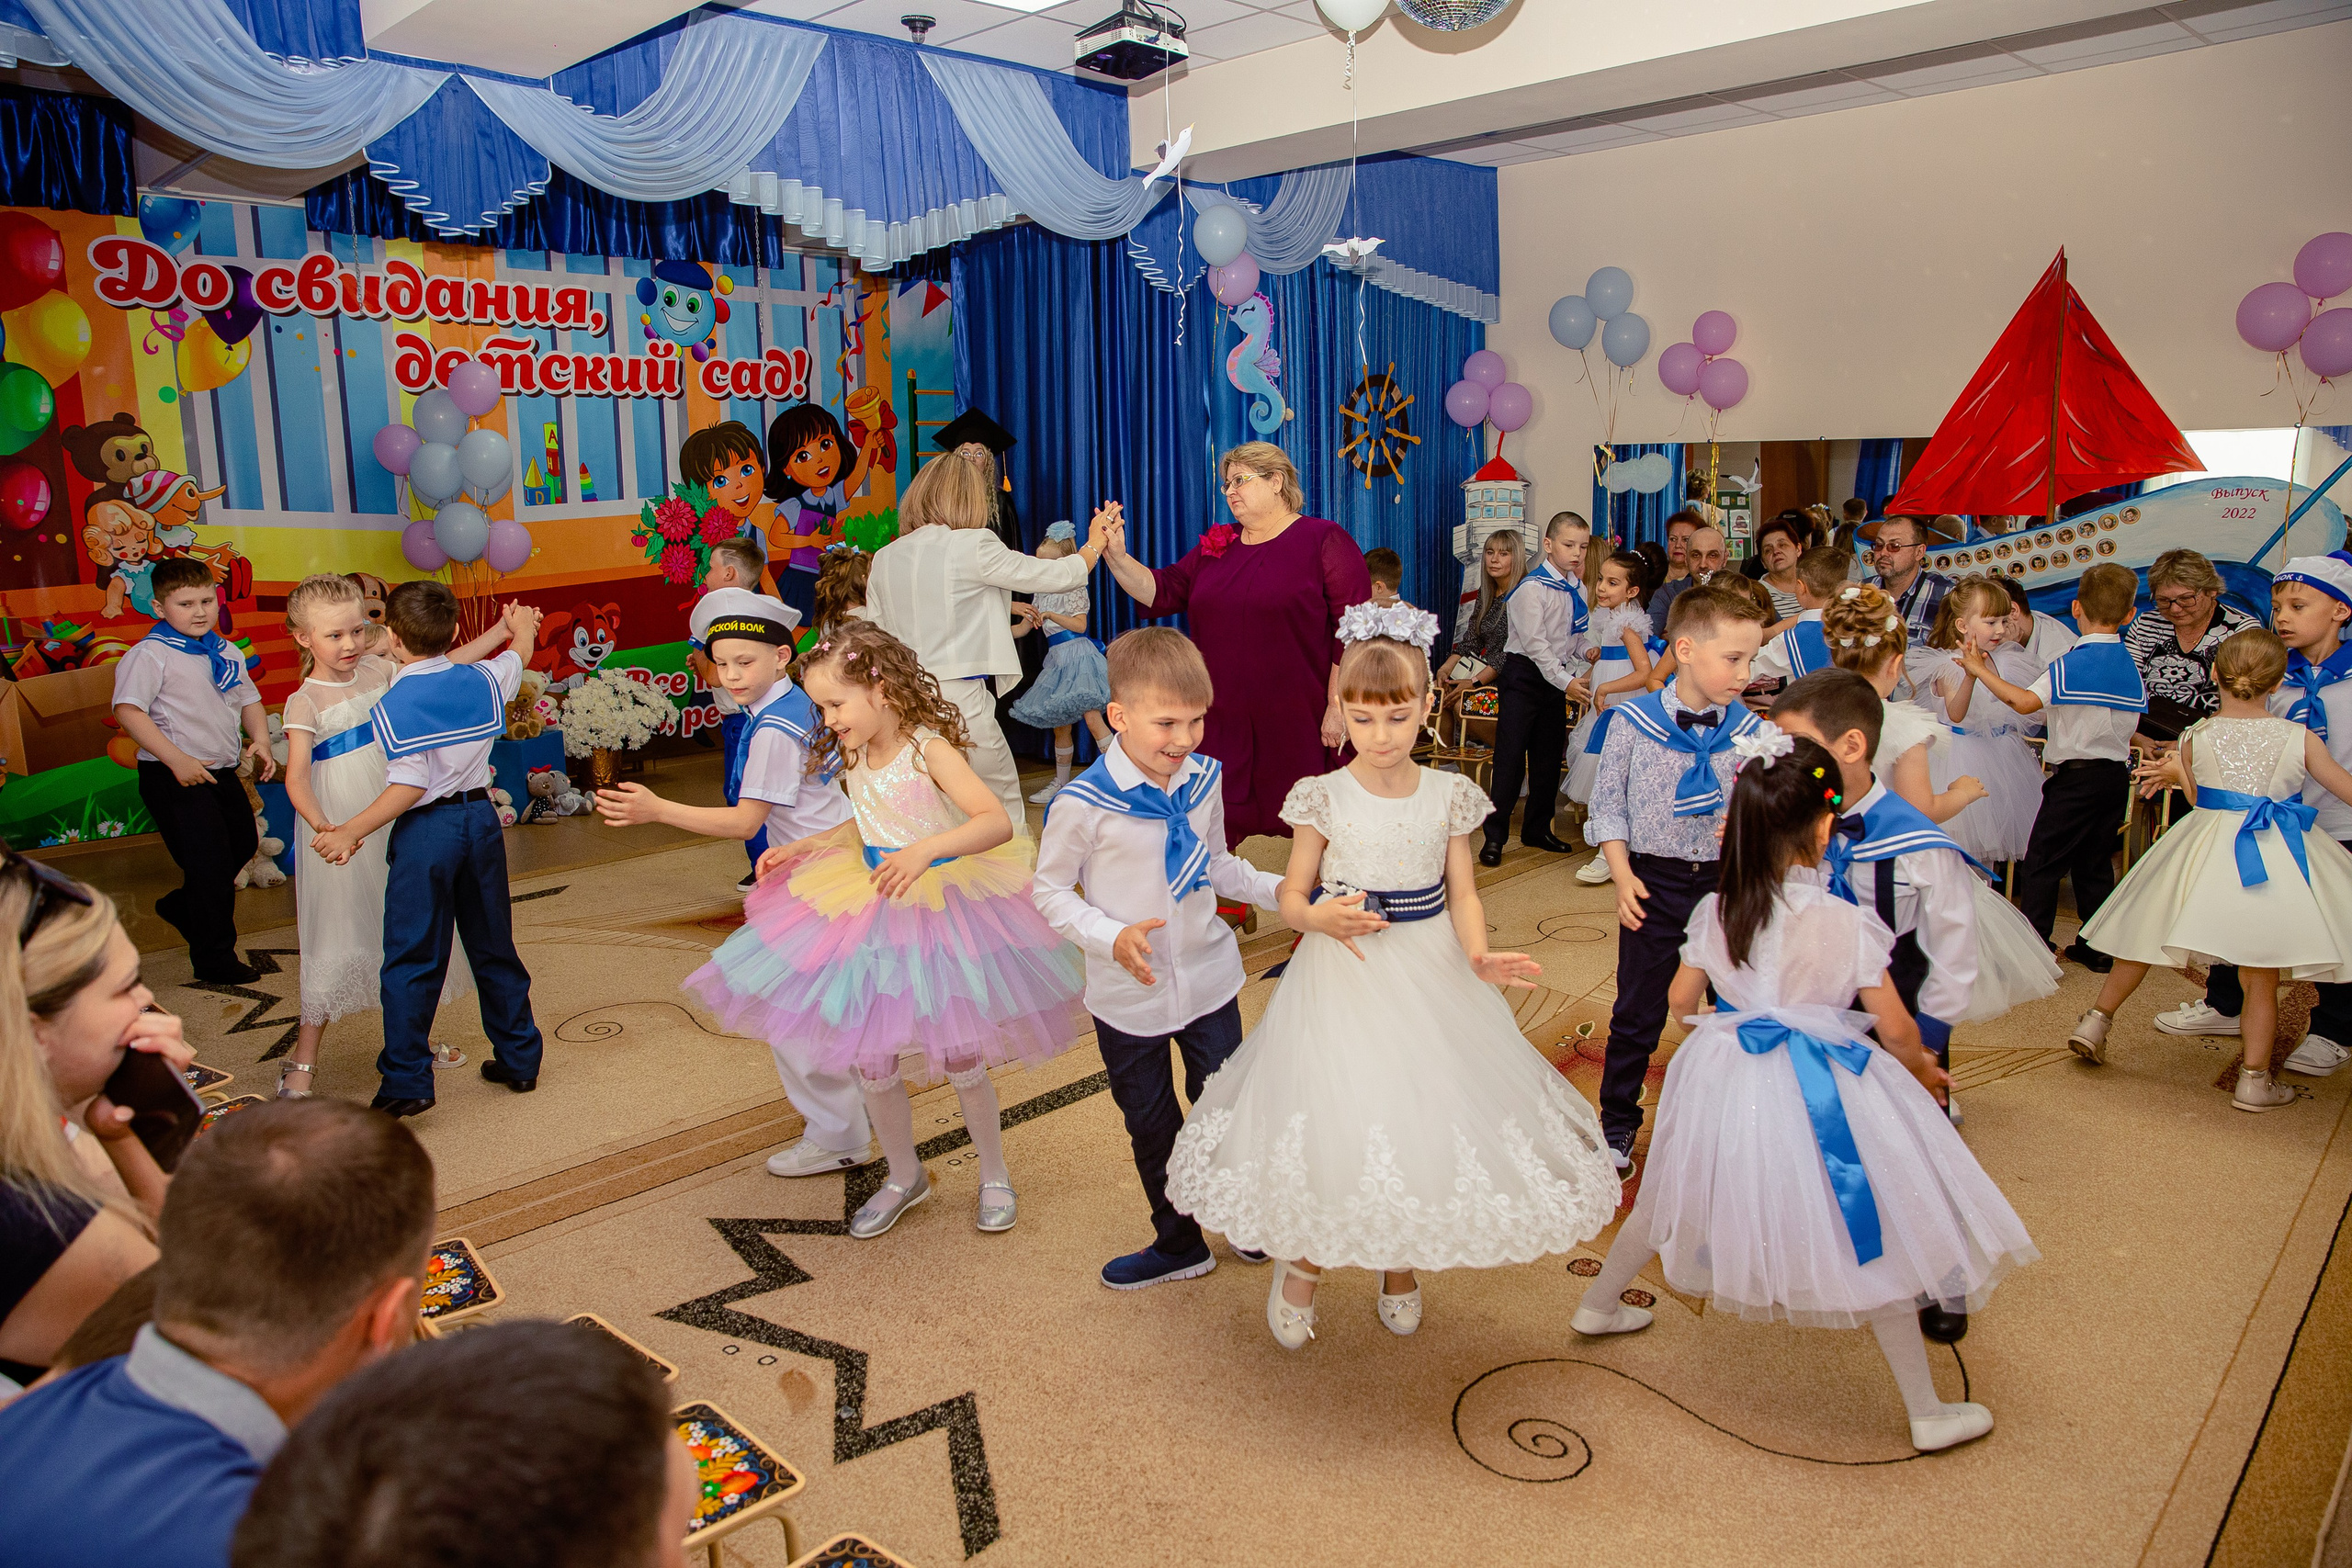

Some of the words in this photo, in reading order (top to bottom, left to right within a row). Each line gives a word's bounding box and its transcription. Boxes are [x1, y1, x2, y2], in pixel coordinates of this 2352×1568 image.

[89, 237, 232, 310] До
[253, 251, 607, 335] свидания,
[699, 345, 808, 399] сад!
[2211, 487, 2270, 502] Выпуск
[2221, 507, 2257, 519] 2022
[740, 622, 764, 634] ВОЛК
